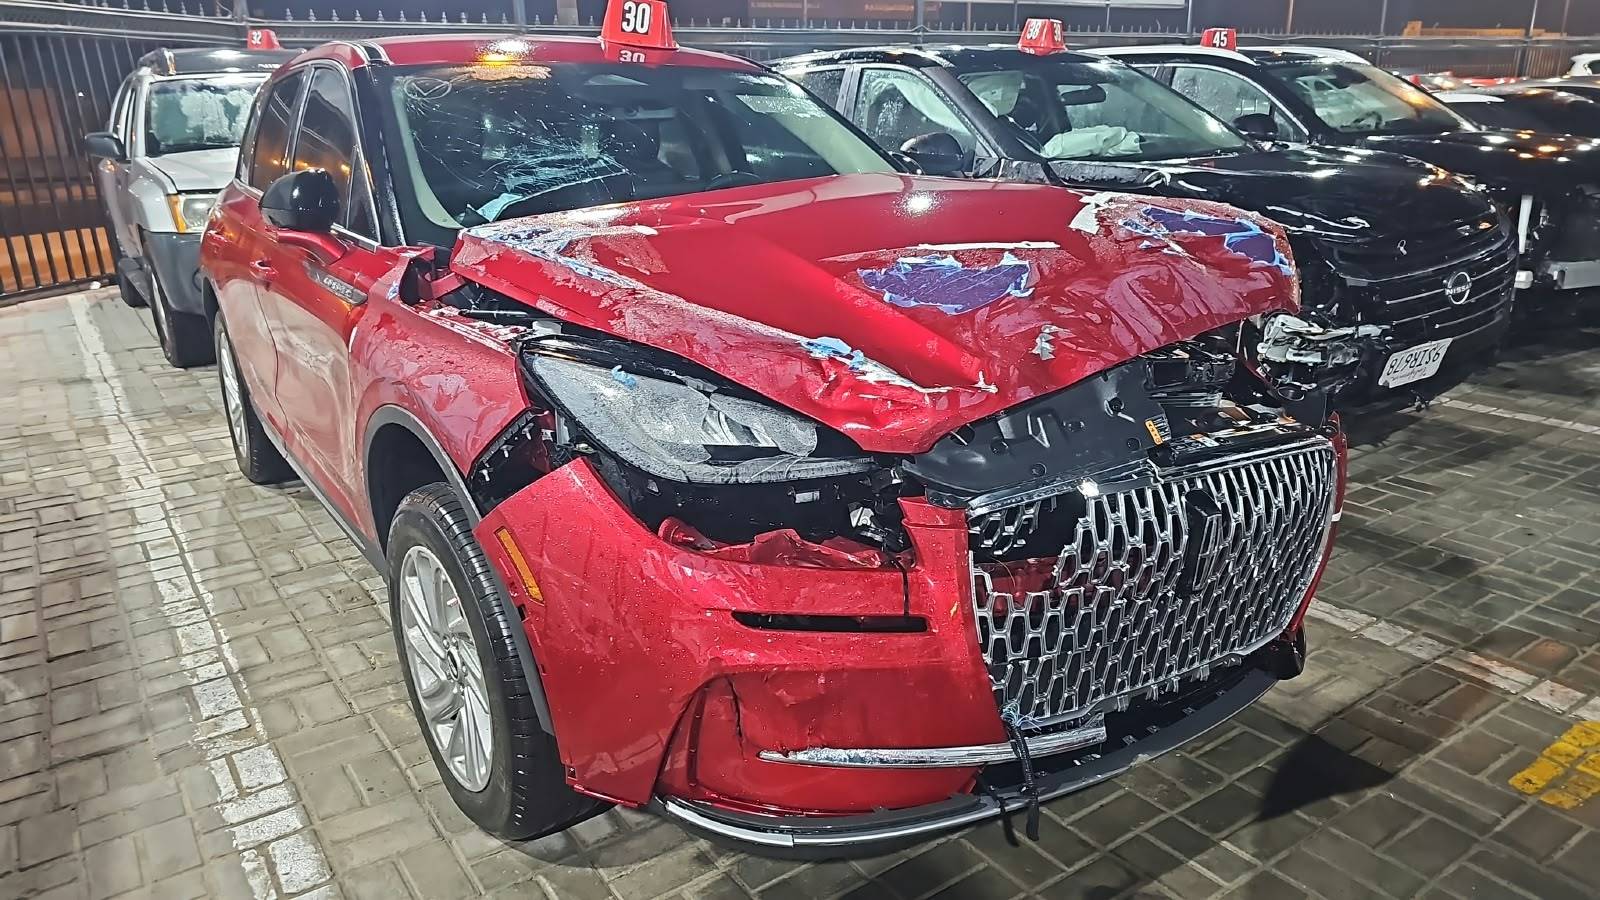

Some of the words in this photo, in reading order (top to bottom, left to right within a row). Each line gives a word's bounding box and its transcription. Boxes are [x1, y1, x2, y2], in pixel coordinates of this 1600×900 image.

[622, 1, 651, 34] 30
[251, 30, 262, 45] 32
[1026, 21, 1041, 40] 38
[1212, 31, 1228, 48] 45
